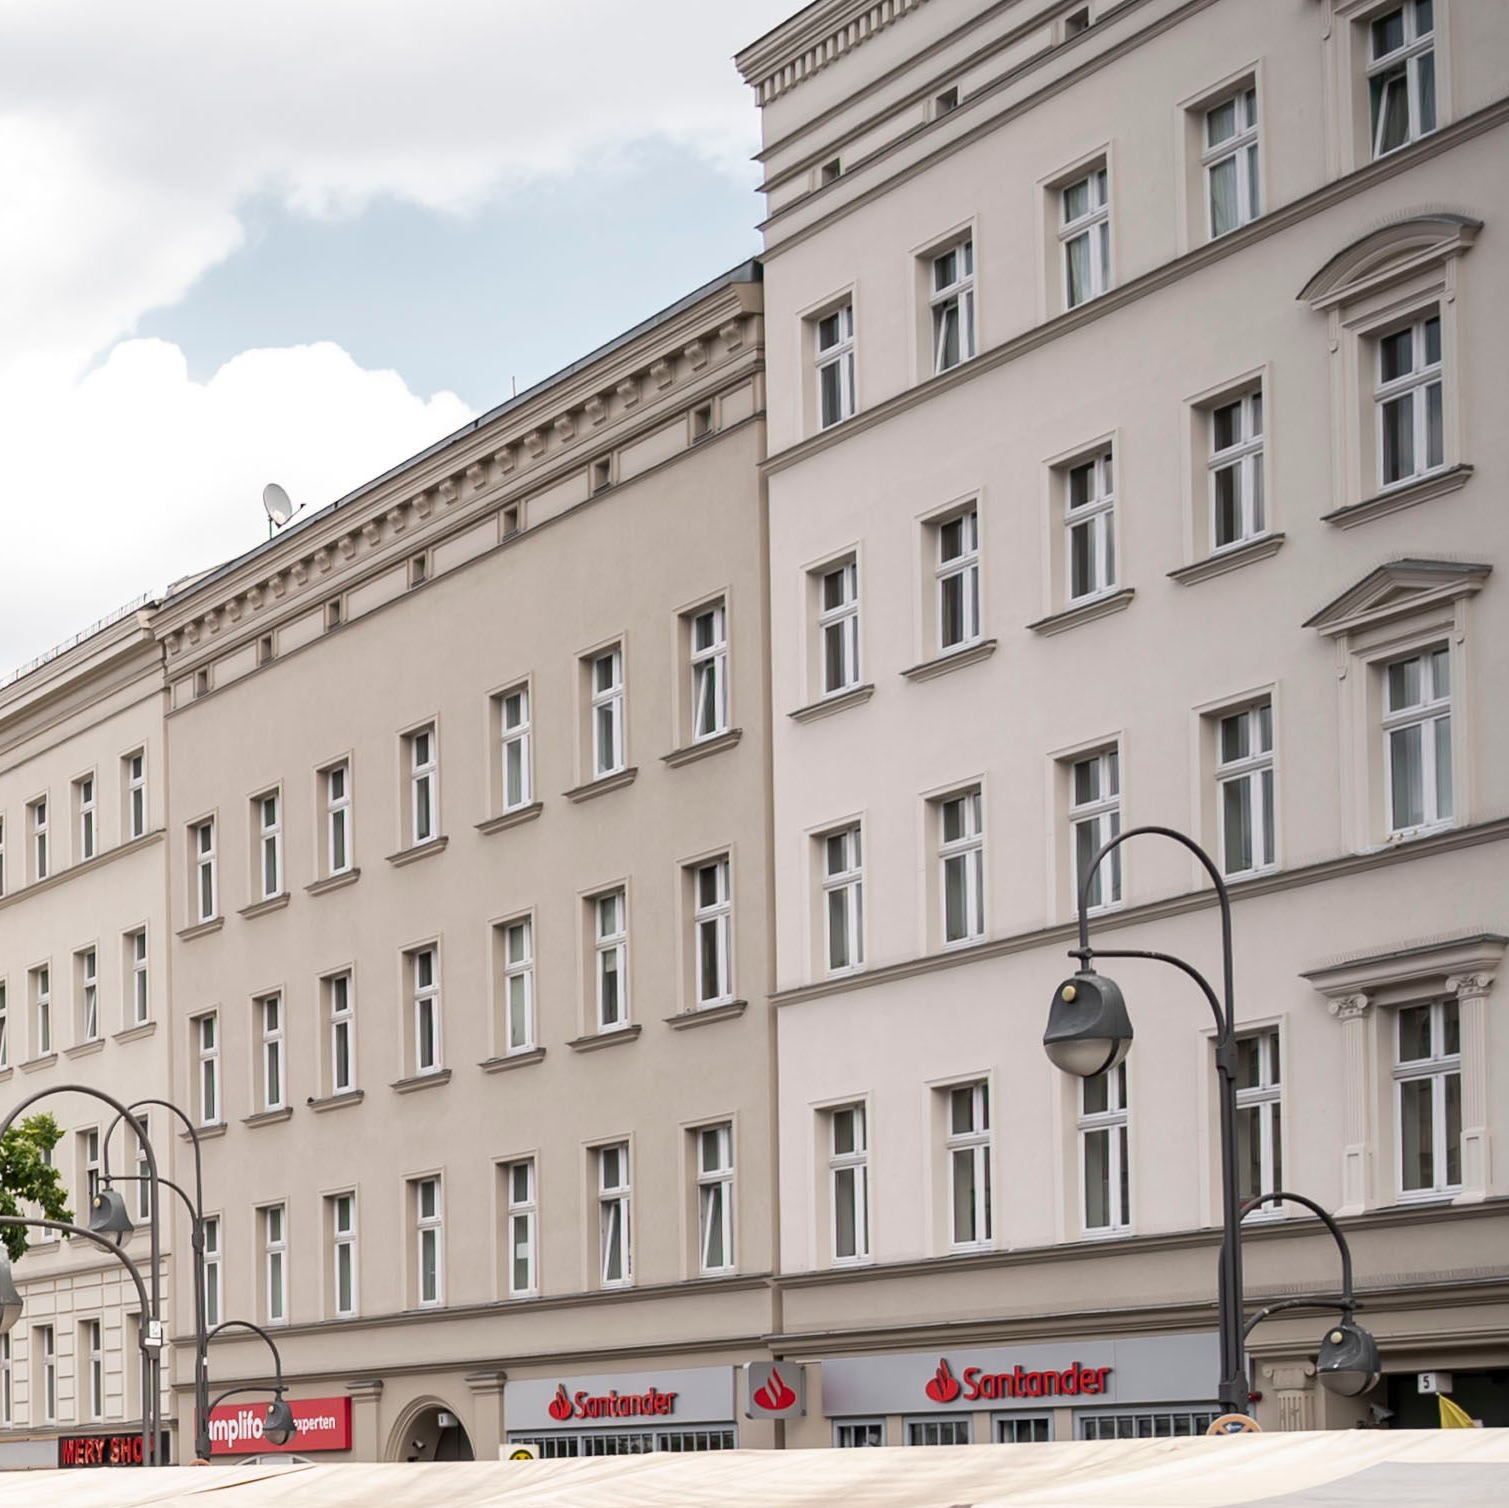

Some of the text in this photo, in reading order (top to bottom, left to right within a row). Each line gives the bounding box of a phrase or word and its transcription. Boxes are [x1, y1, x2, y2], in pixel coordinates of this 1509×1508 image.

[963, 1361, 1113, 1401] Santander
[1423, 1375, 1430, 1390] 5
[573, 1386, 679, 1419] Santander
[110, 1435, 153, 1465] SHO
